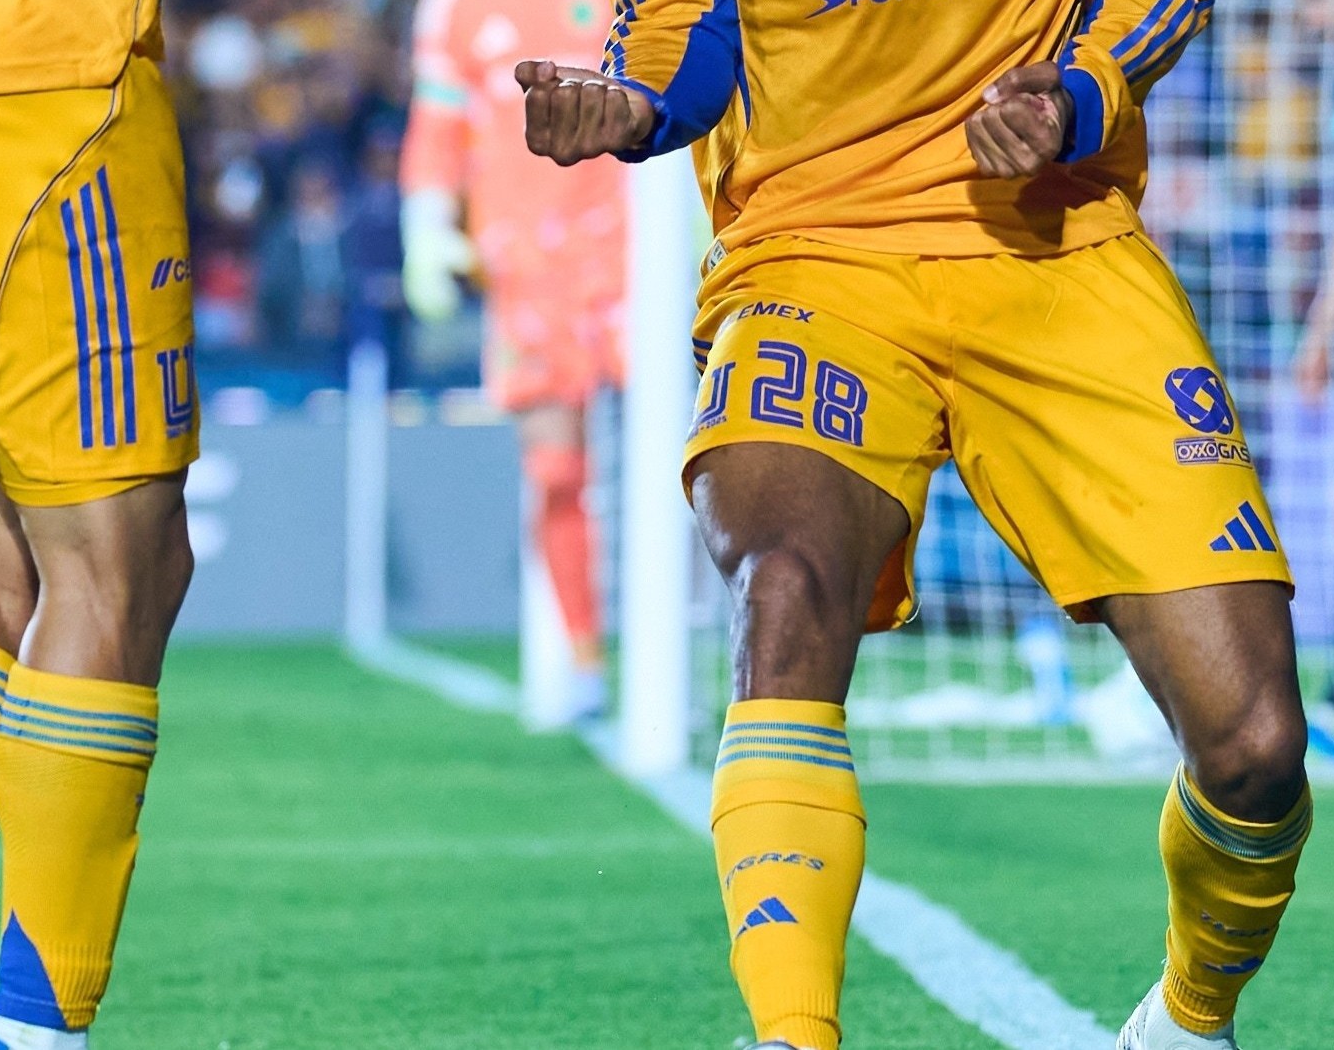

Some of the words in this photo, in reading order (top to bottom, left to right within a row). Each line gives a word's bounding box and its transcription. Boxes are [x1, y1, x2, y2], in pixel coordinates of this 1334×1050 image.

[737, 301, 815, 324] EMEX
[750, 340, 868, 448] 28
[1178, 443, 1217, 460] OXXO
[1218, 442, 1250, 463] GAS
